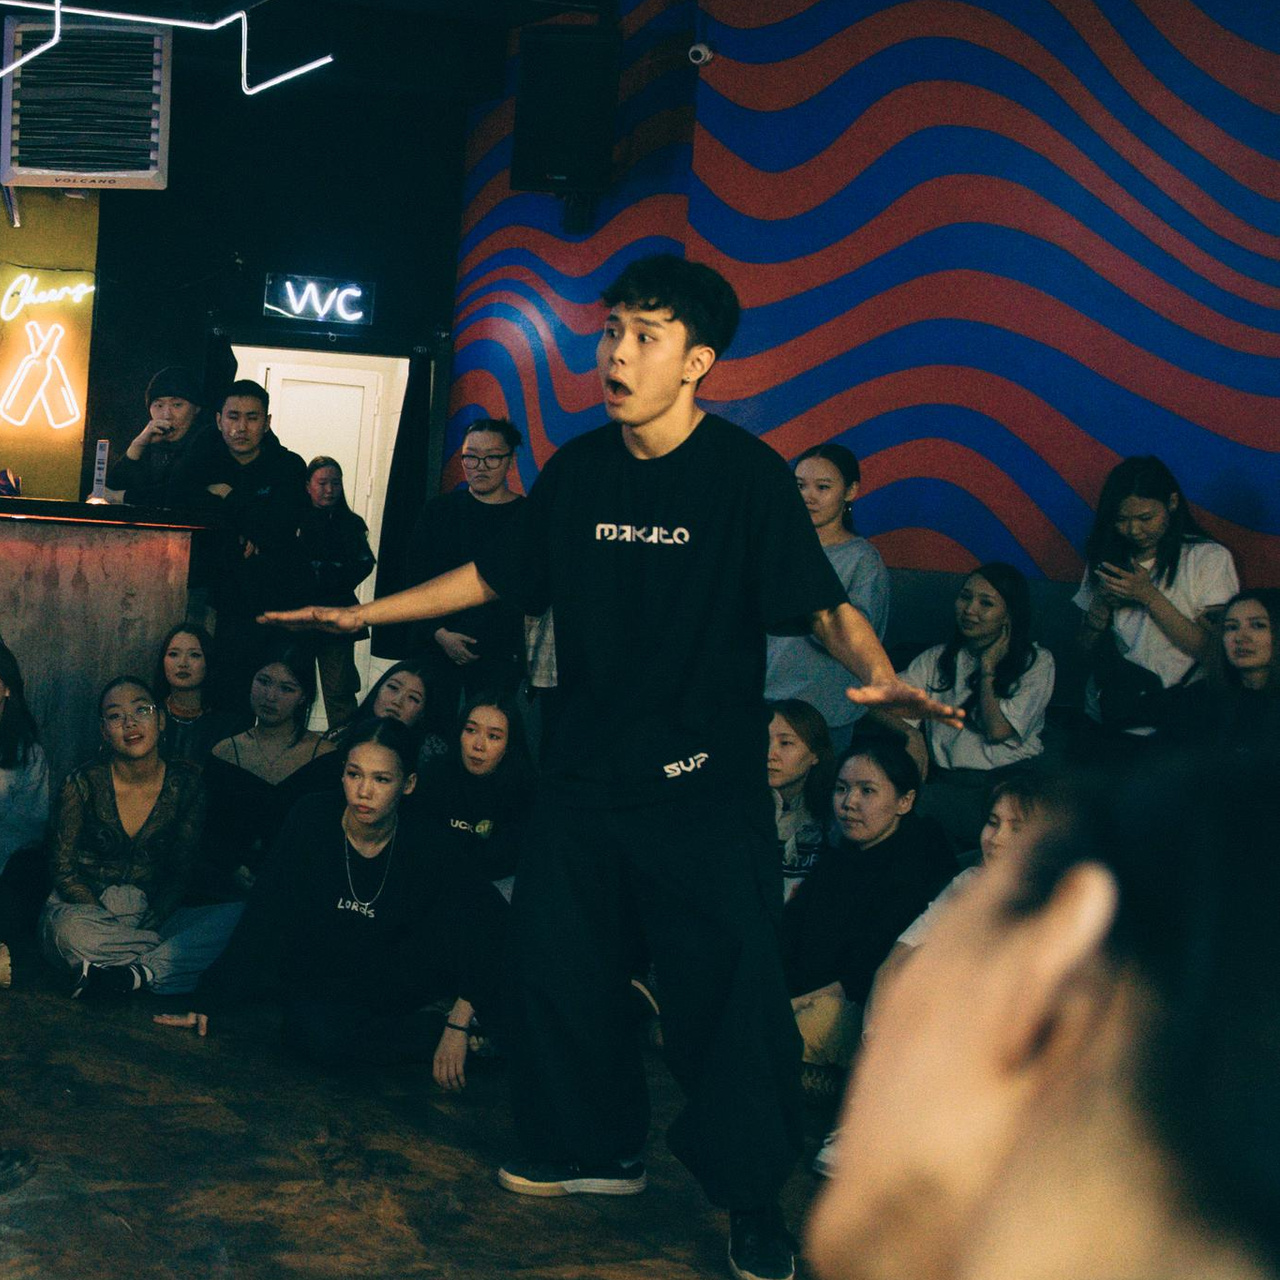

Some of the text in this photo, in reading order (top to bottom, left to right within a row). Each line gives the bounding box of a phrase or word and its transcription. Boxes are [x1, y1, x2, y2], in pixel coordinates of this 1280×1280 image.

[54, 177, 117, 185] VOLCANO
[0, 273, 96, 322] Cheers
[285, 280, 364, 322] WC
